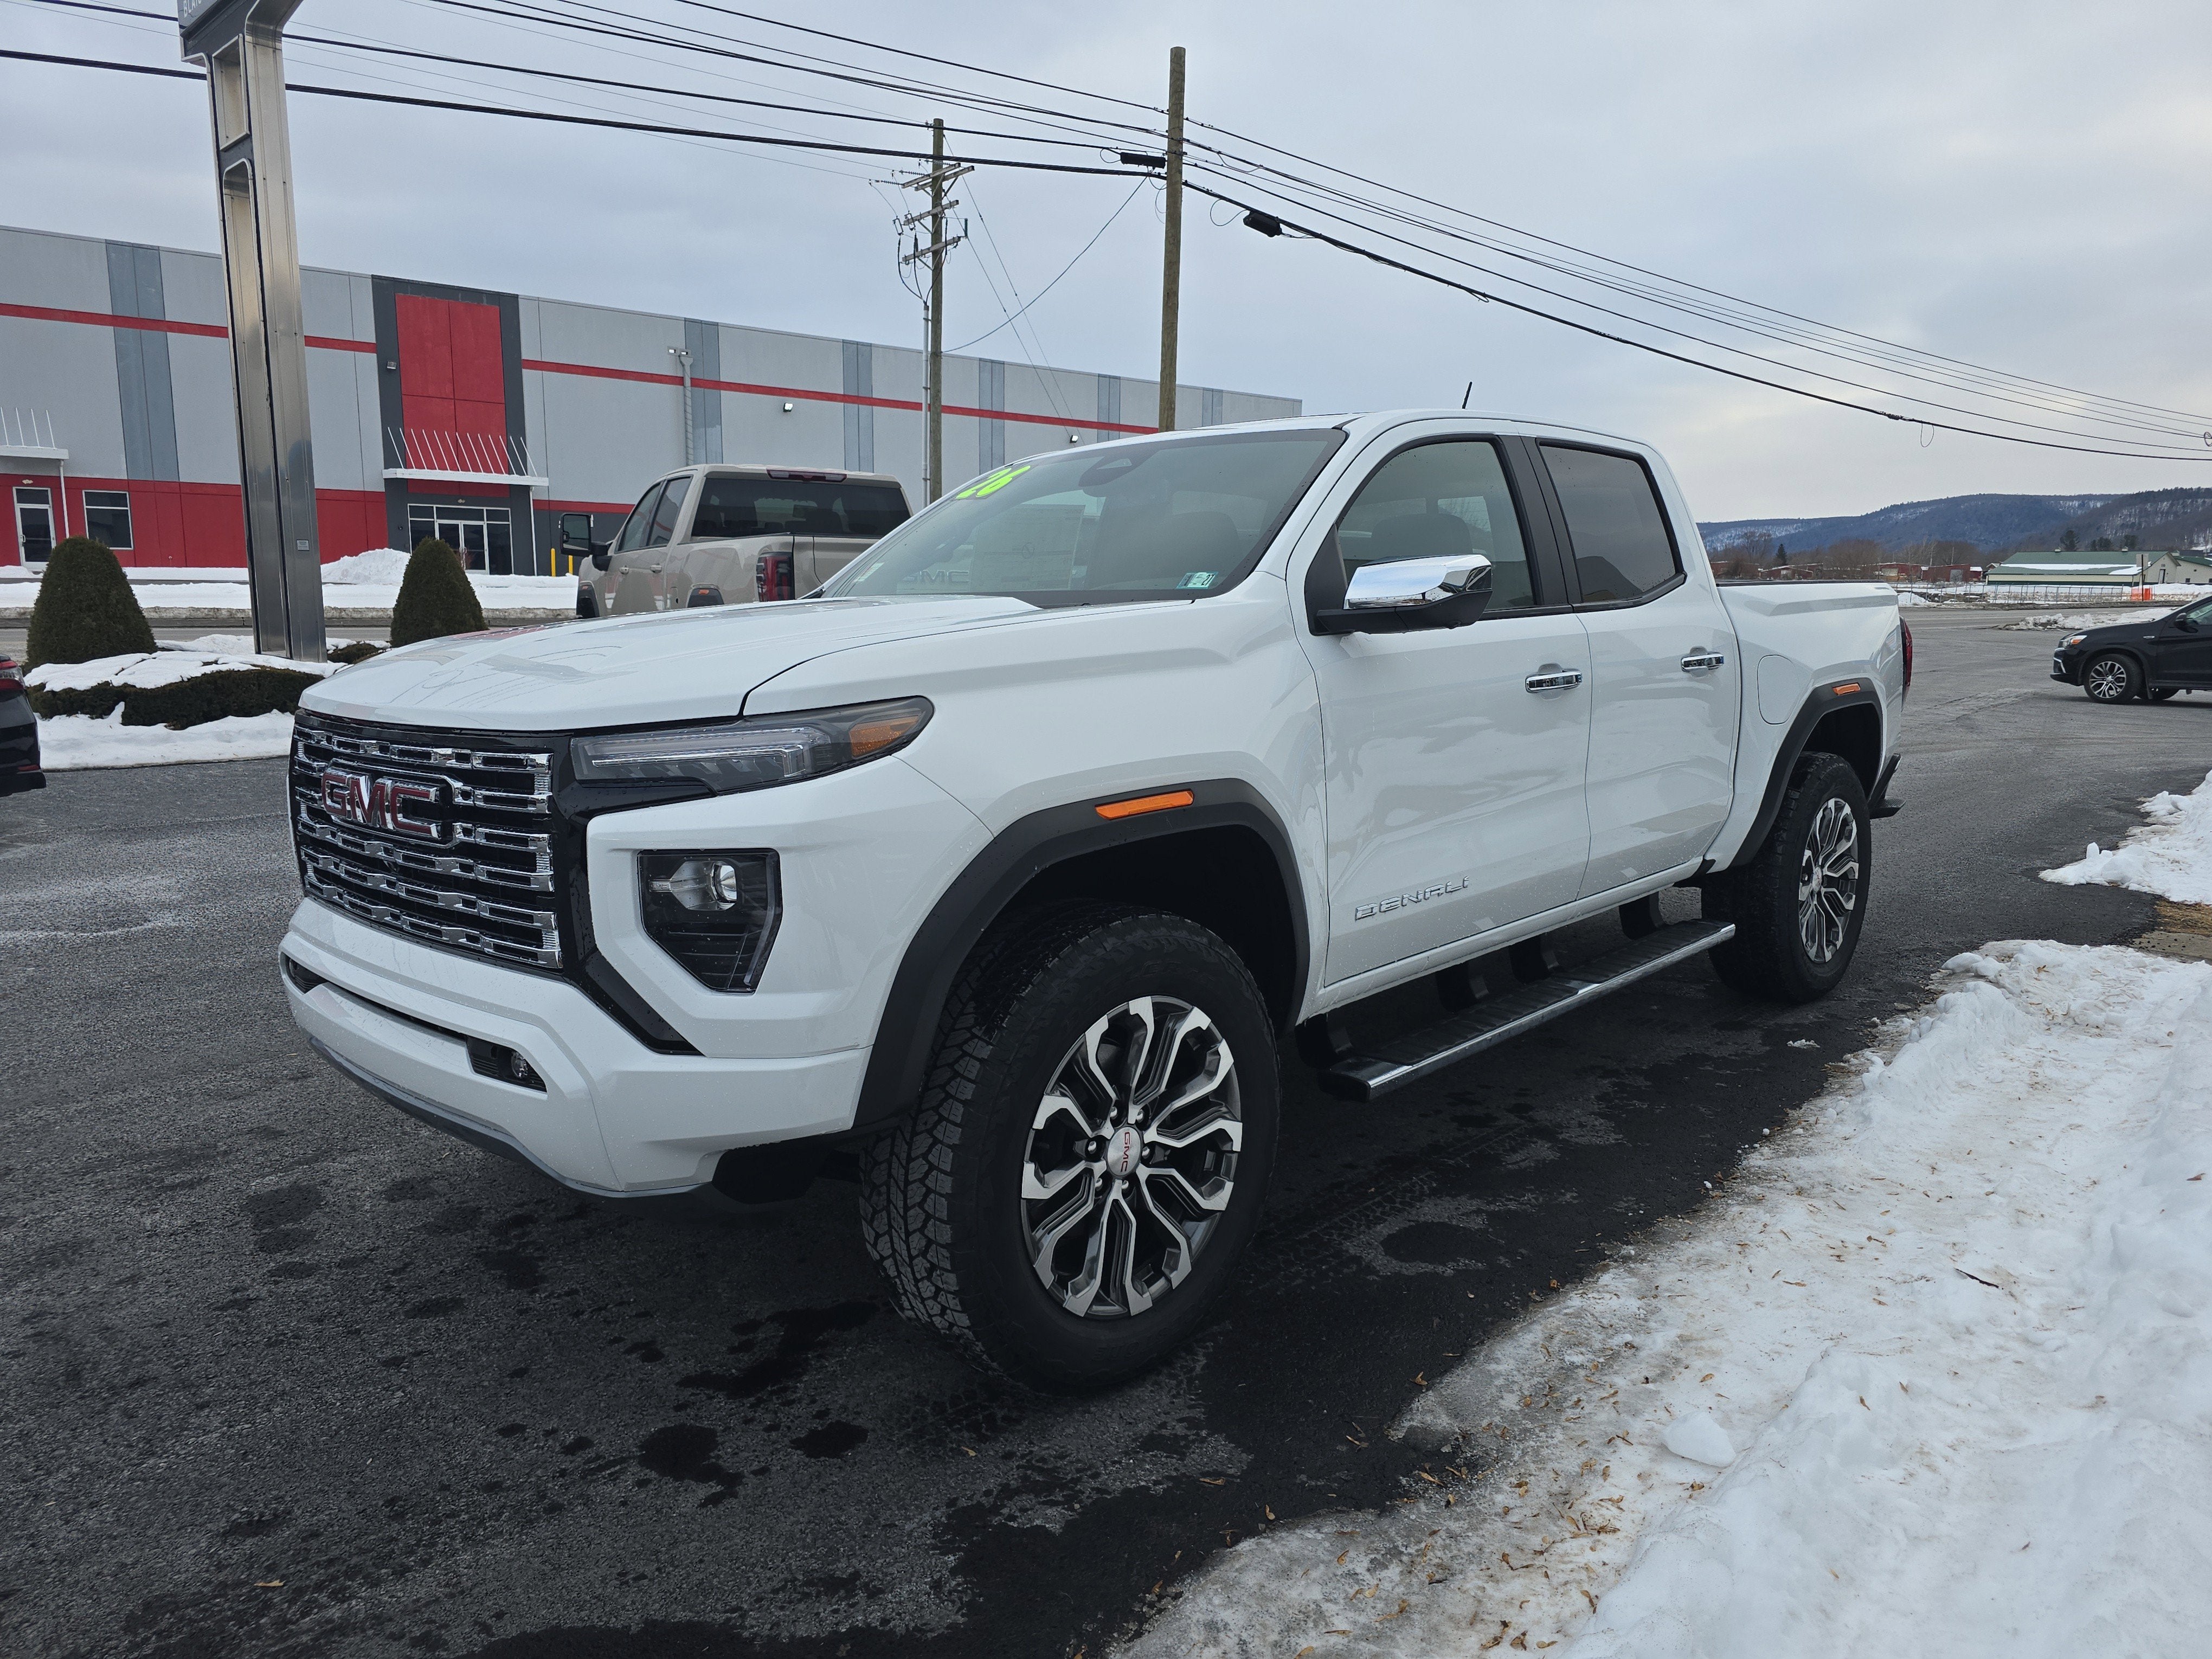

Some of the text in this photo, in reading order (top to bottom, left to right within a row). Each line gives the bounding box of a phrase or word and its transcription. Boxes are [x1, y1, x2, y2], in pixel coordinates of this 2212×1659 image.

[955, 466, 1031, 499] 26
[1201, 574, 1215, 586] 27
[322, 766, 440, 839] GMC
[1355, 876, 1469, 922] DENALI
[1120, 1131, 1130, 1172] GMC
